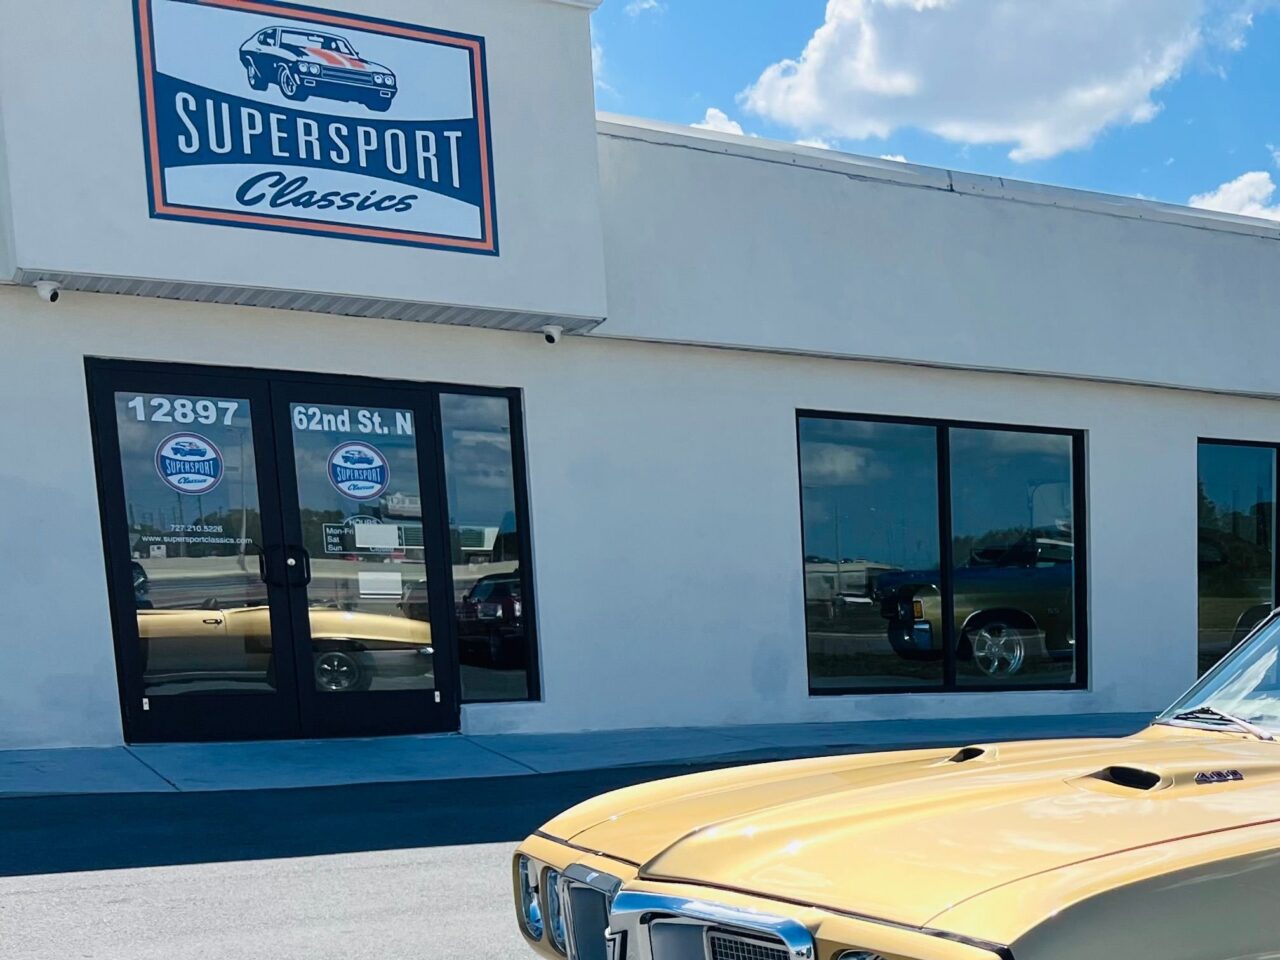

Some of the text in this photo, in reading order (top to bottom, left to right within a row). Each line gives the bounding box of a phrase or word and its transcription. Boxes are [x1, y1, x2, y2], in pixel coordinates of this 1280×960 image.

[175, 91, 462, 189] SUPERSPORT
[235, 171, 418, 212] Classics
[128, 396, 238, 425] 12897
[293, 406, 413, 435] 62nd St. N
[165, 459, 214, 476] SUPERSPORT
[336, 467, 381, 482] SUPERSPORT
[142, 535, 252, 545] www.supersportclassics.com
[326, 527, 353, 535] Mon-Fri
